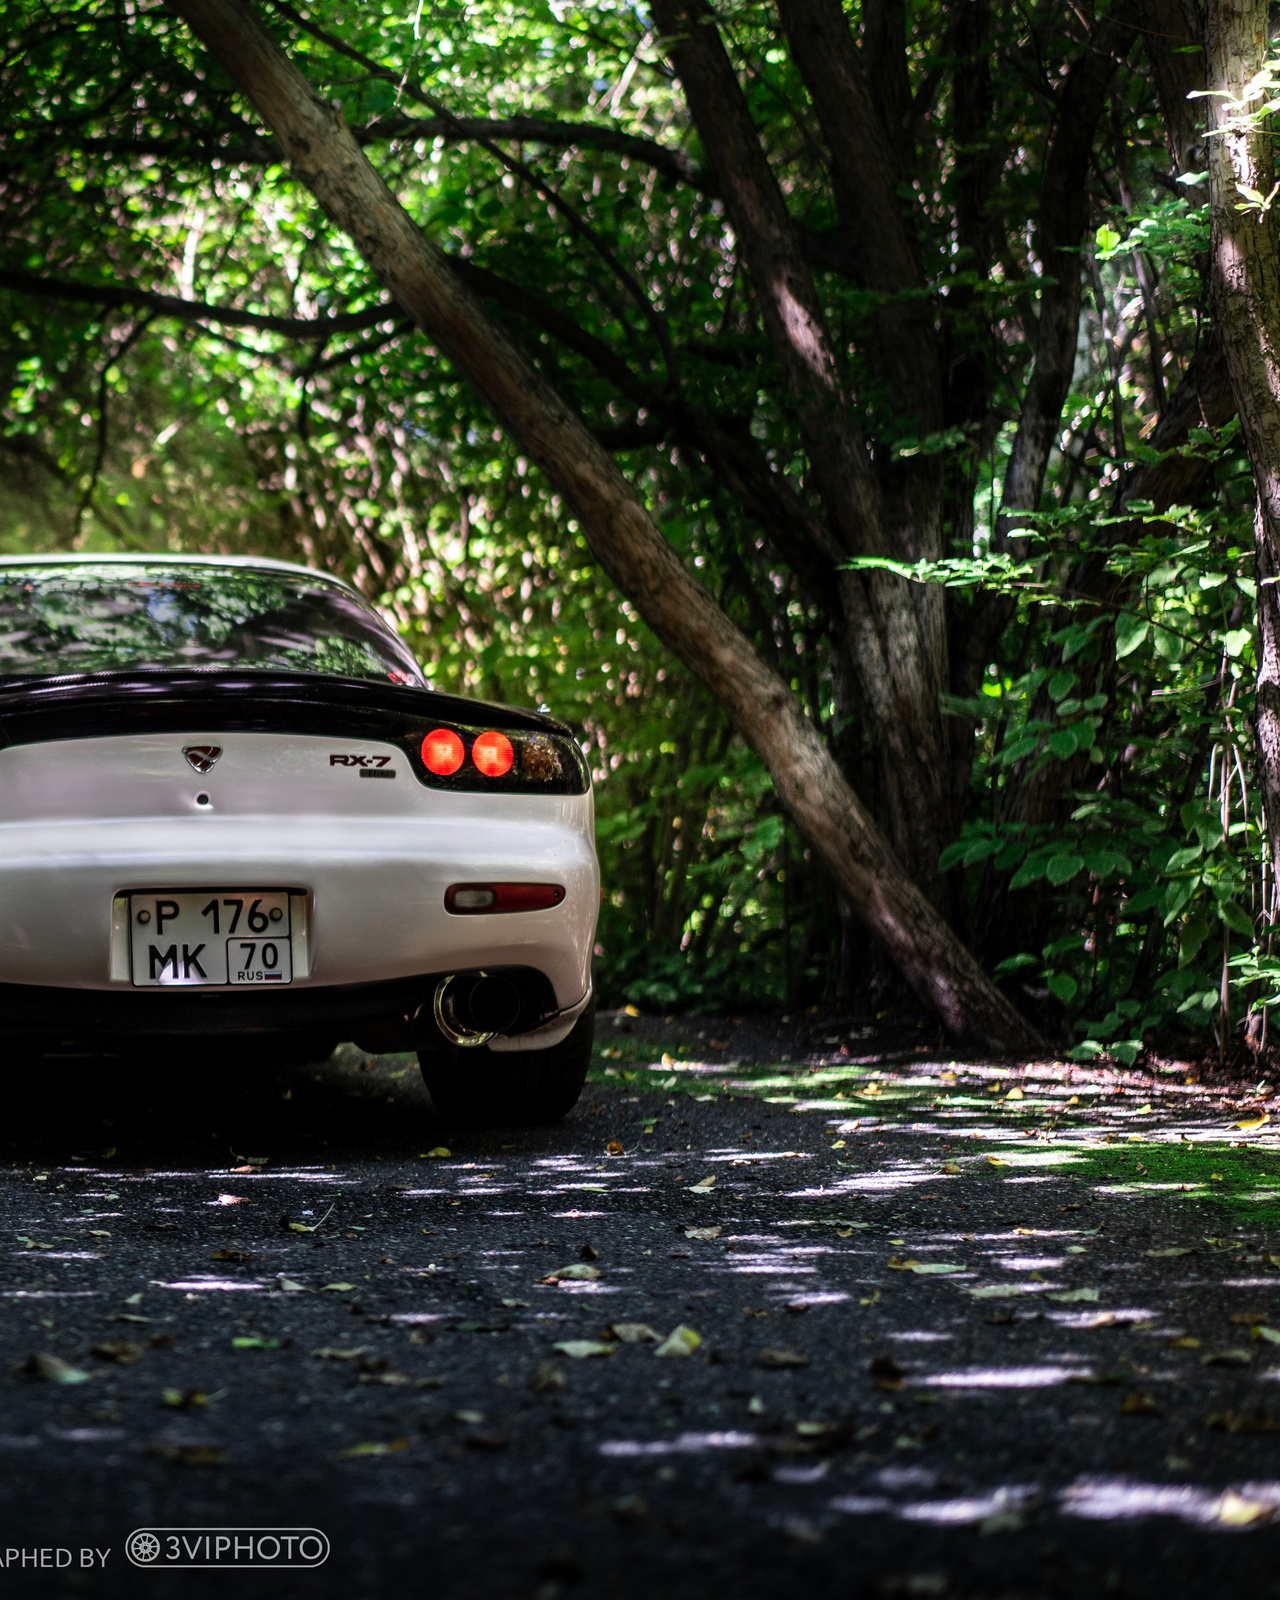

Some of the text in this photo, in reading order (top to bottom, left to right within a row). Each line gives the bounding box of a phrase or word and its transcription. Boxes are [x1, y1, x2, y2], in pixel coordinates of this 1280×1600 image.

[329, 754, 391, 768] RX-7
[156, 899, 268, 935] P 176
[149, 943, 207, 979] MK
[240, 942, 278, 970] 70
[237, 971, 263, 980] RUS
